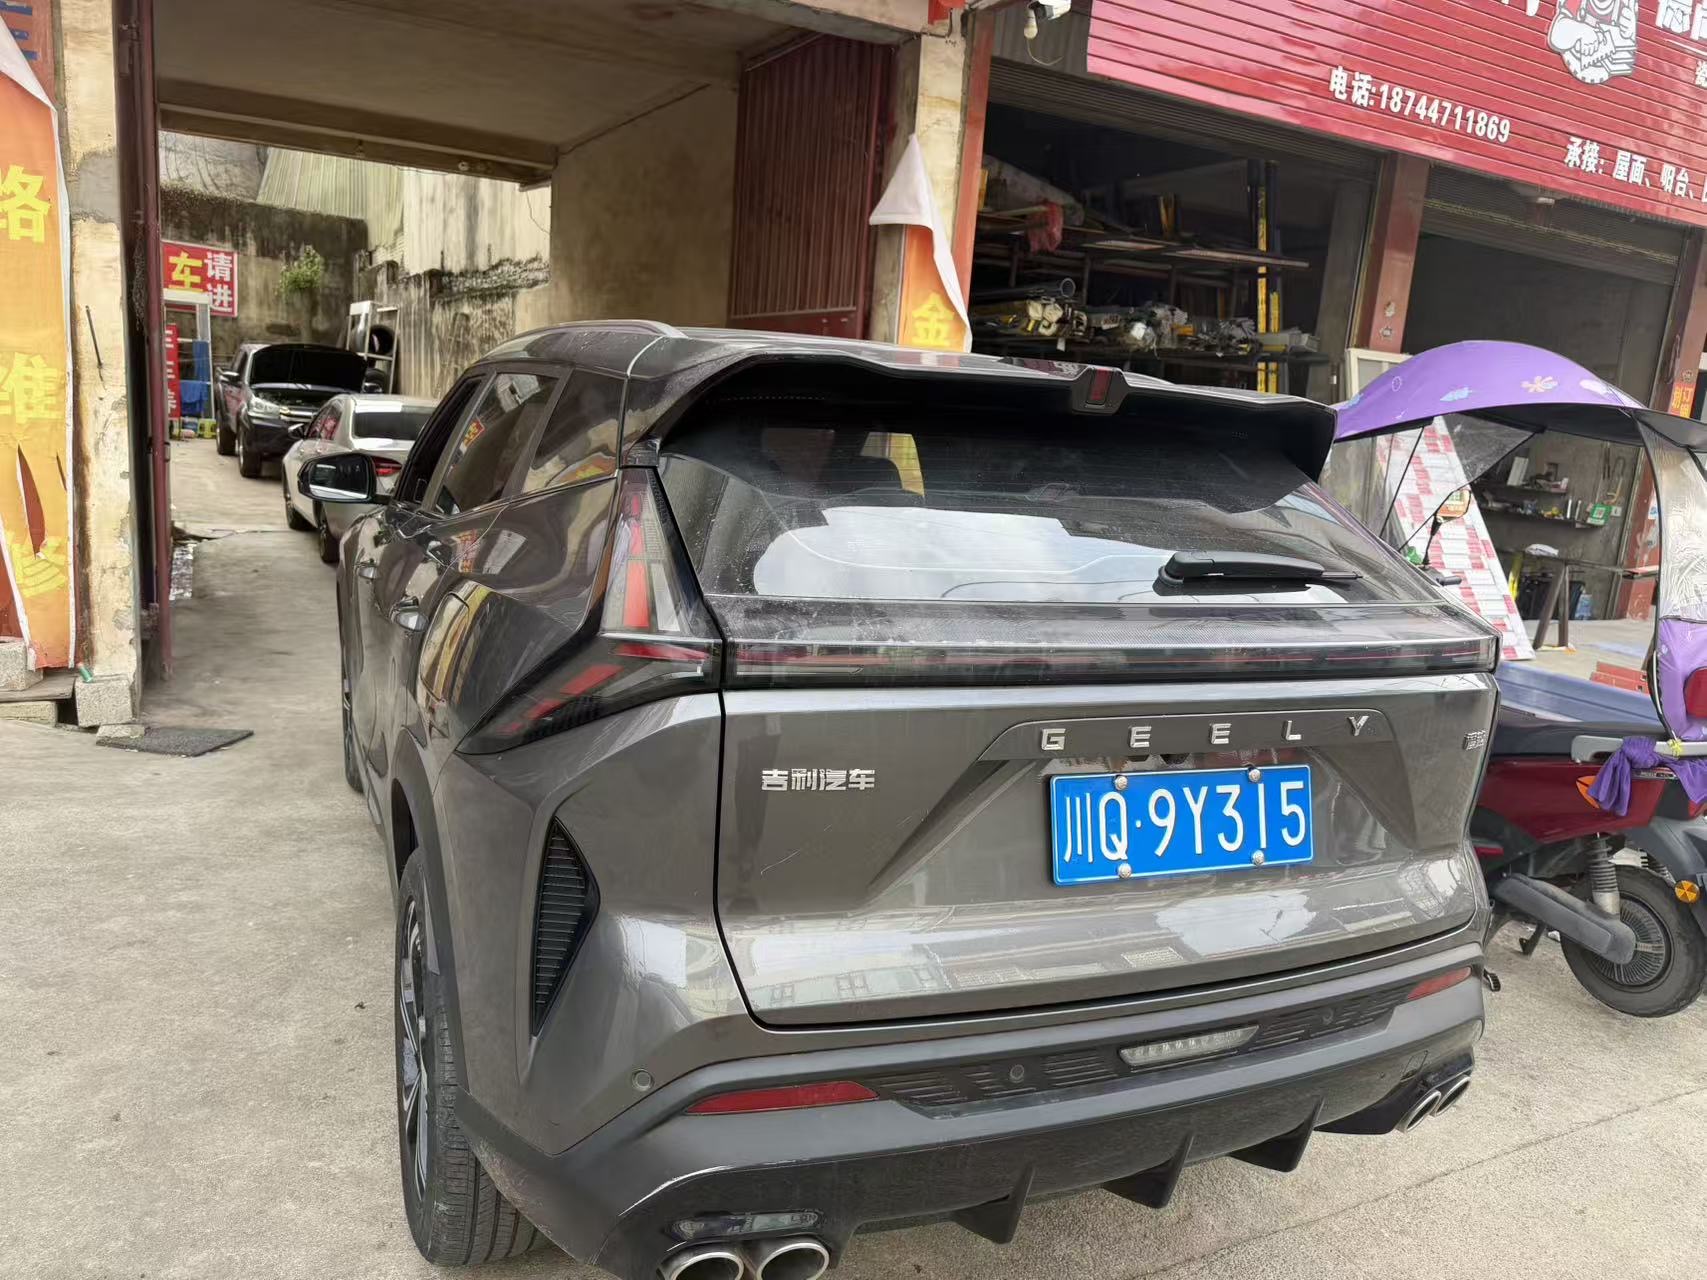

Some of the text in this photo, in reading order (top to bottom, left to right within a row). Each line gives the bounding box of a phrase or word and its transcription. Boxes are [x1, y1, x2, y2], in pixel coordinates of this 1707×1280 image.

[168, 251, 204, 293] 车
[203, 251, 233, 313] 请进
[911, 292, 955, 346] 金
[1041, 715, 1370, 751] GEELY
[761, 768, 876, 791] 吉利汽车
[1063, 780, 1306, 863] 川Q·9Y315
